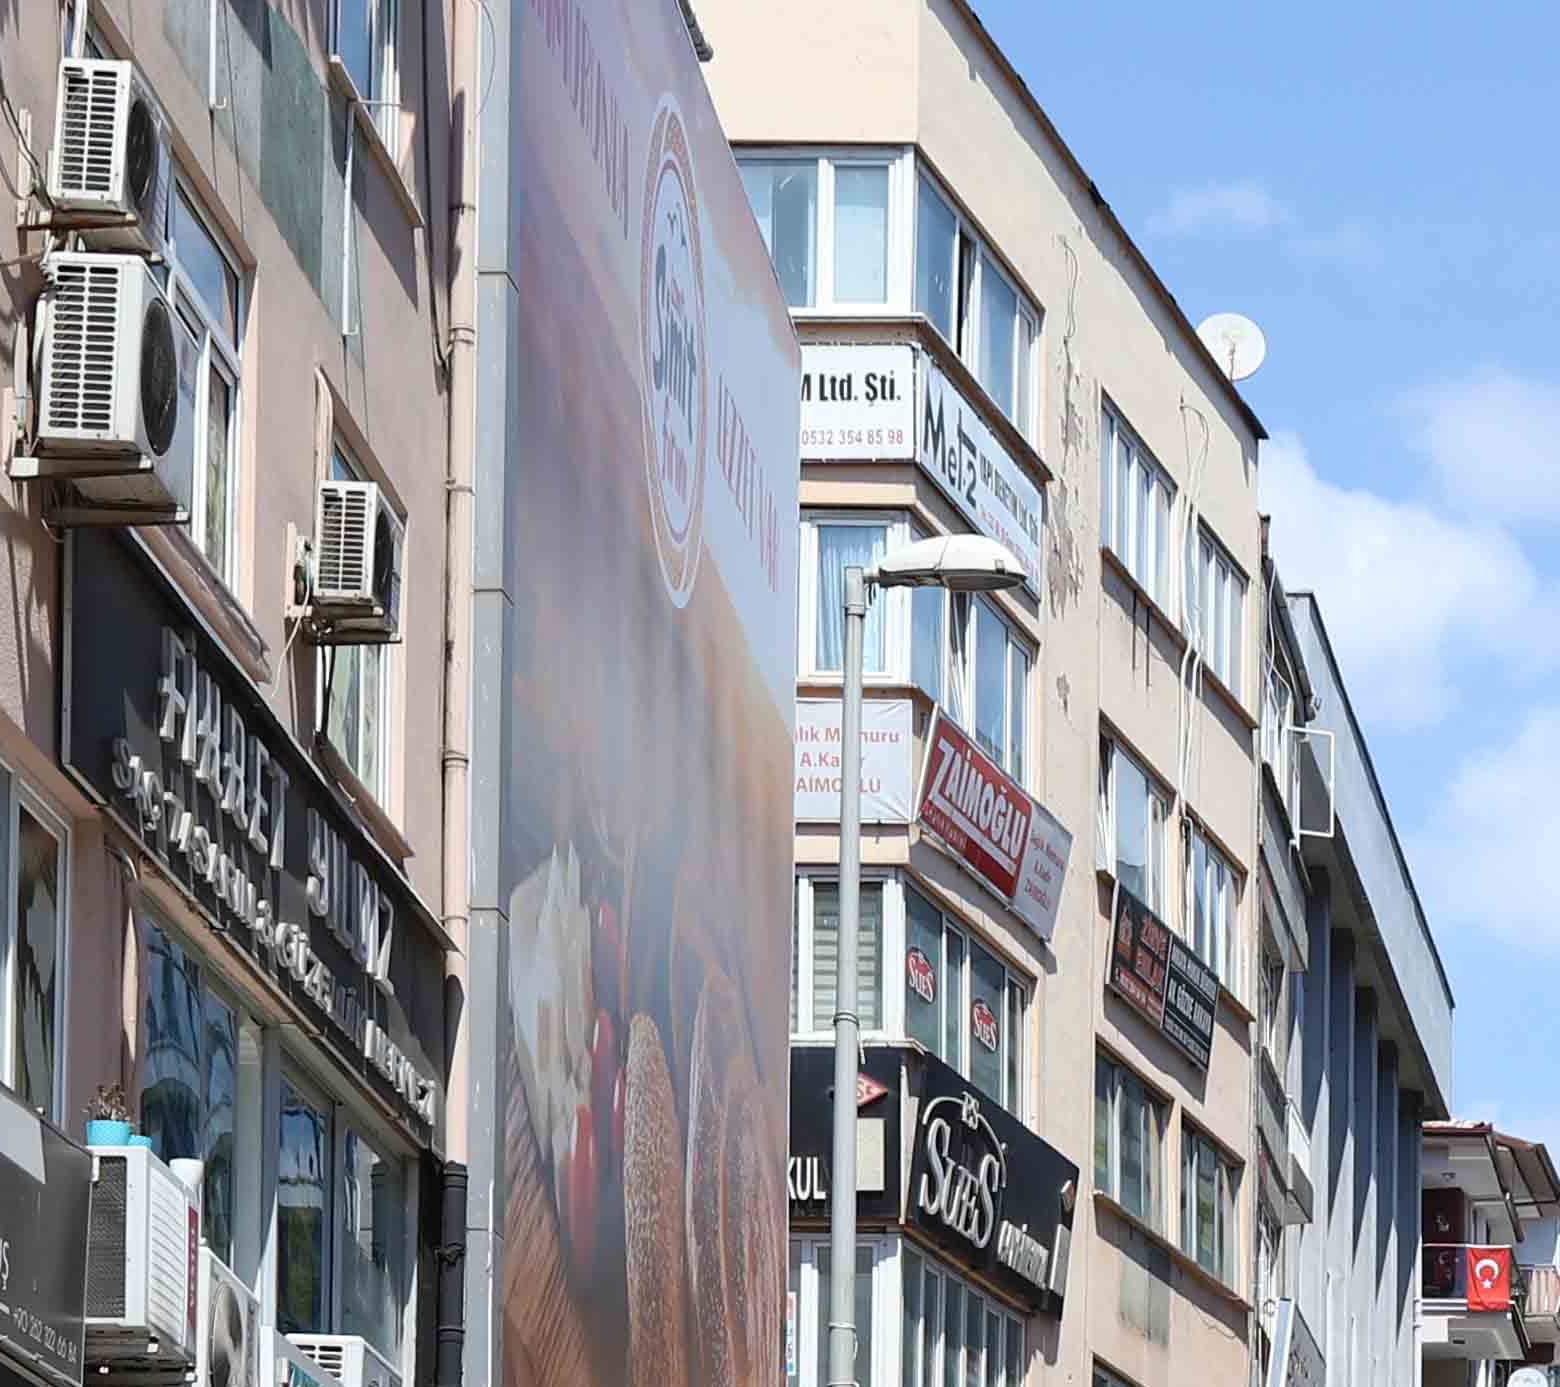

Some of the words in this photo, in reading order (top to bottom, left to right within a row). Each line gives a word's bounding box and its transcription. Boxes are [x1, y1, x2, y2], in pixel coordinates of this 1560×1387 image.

[818, 375, 859, 402] Ltd.
[864, 372, 902, 408] Şti.
[801, 429, 835, 445] 0532
[838, 429, 864, 445] 354
[866, 429, 884, 445] 85
[886, 429, 904, 445] 98
[938, 740, 1030, 847] ZAİMOĞLU
